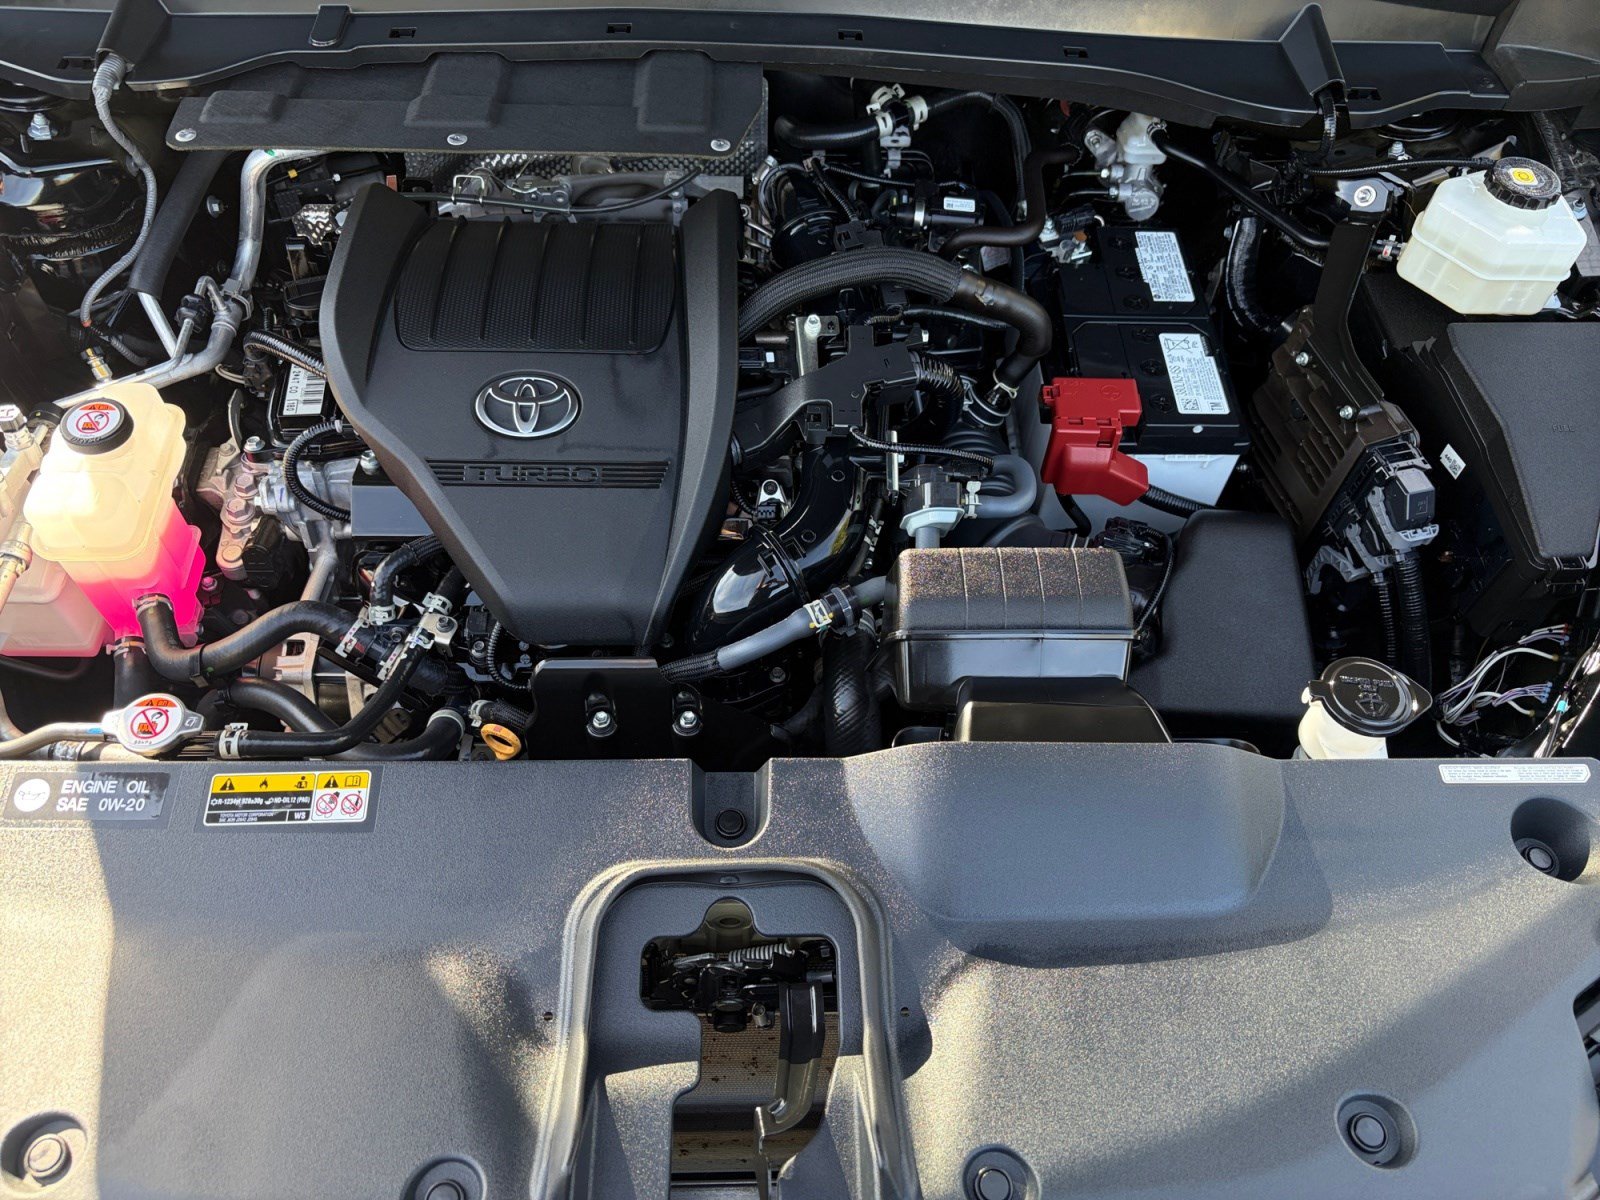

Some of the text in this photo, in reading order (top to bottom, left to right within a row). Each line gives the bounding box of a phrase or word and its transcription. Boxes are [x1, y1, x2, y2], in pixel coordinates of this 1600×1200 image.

[467, 464, 598, 481] TURBO
[61, 780, 150, 794] ENGINE OIL
[56, 798, 145, 812] SAE 0W-20
